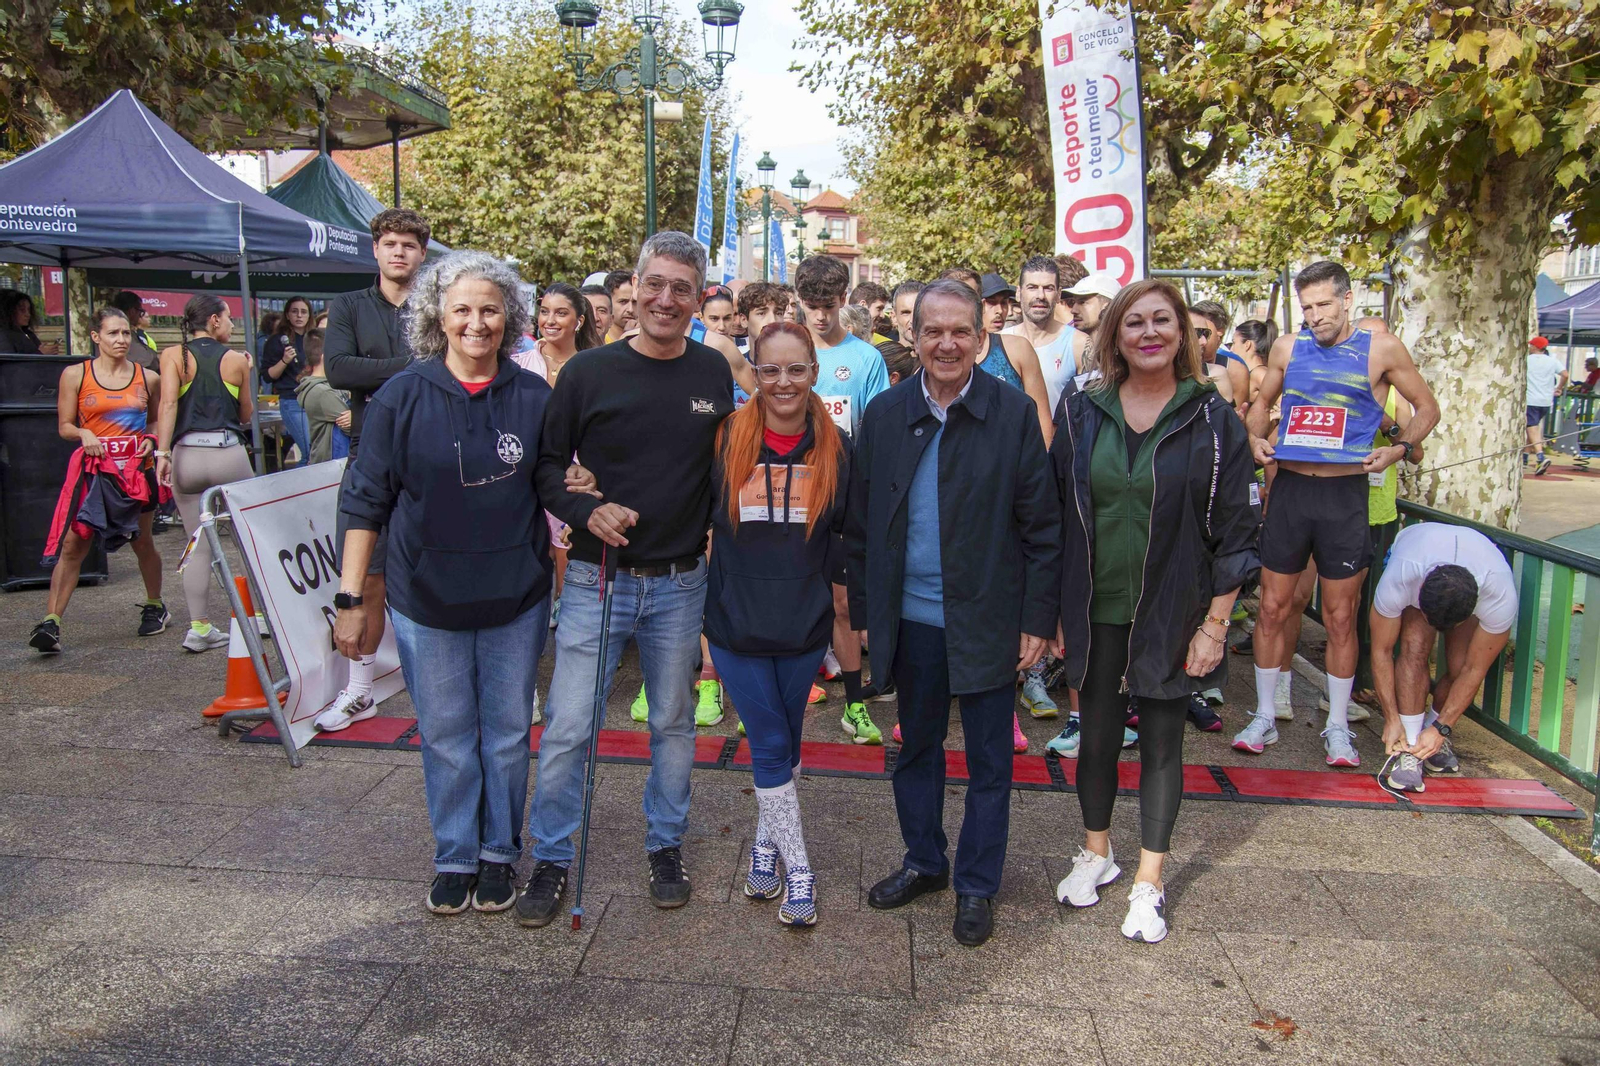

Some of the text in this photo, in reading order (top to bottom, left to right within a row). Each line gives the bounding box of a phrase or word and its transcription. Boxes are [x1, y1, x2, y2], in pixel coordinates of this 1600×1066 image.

[1078, 25, 1124, 43] CONCELLO
[1084, 36, 1119, 51] DE VIGO
[1058, 82, 1085, 184] deporte
[1084, 78, 1102, 179] o teu mellor
[0, 202, 77, 219] eputación
[0, 218, 78, 233] ontevedra
[701, 214, 713, 239] DE
[328, 226, 358, 244] Deputación
[328, 239, 359, 256] Pontevedra
[1302, 411, 1336, 427] 223
[101, 441, 129, 454] 137
[1210, 465, 1219, 497] PRIVATE
